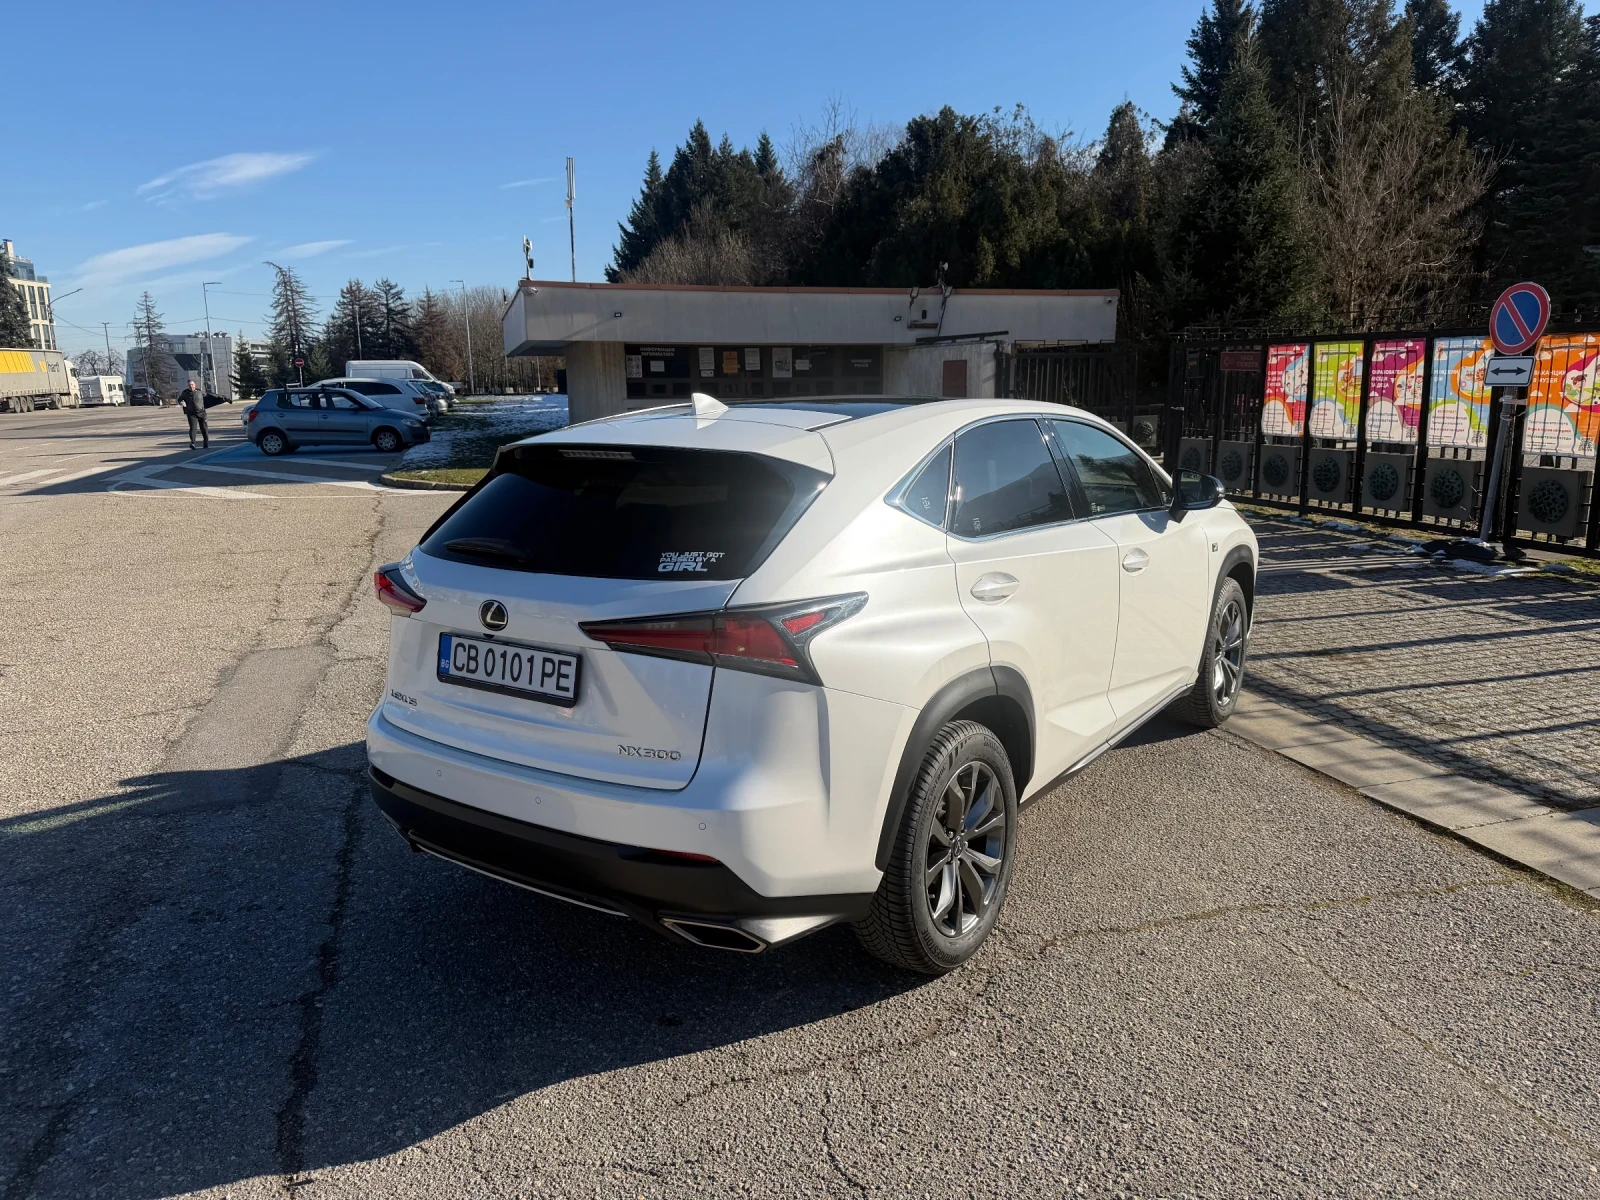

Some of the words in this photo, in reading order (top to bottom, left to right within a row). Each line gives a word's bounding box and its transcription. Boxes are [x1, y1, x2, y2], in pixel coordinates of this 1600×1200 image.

[657, 561, 708, 572] GIRL
[441, 658, 450, 668] BG
[617, 744, 682, 761] NX300
[920, 926, 960, 965] BRIDGESTONE
